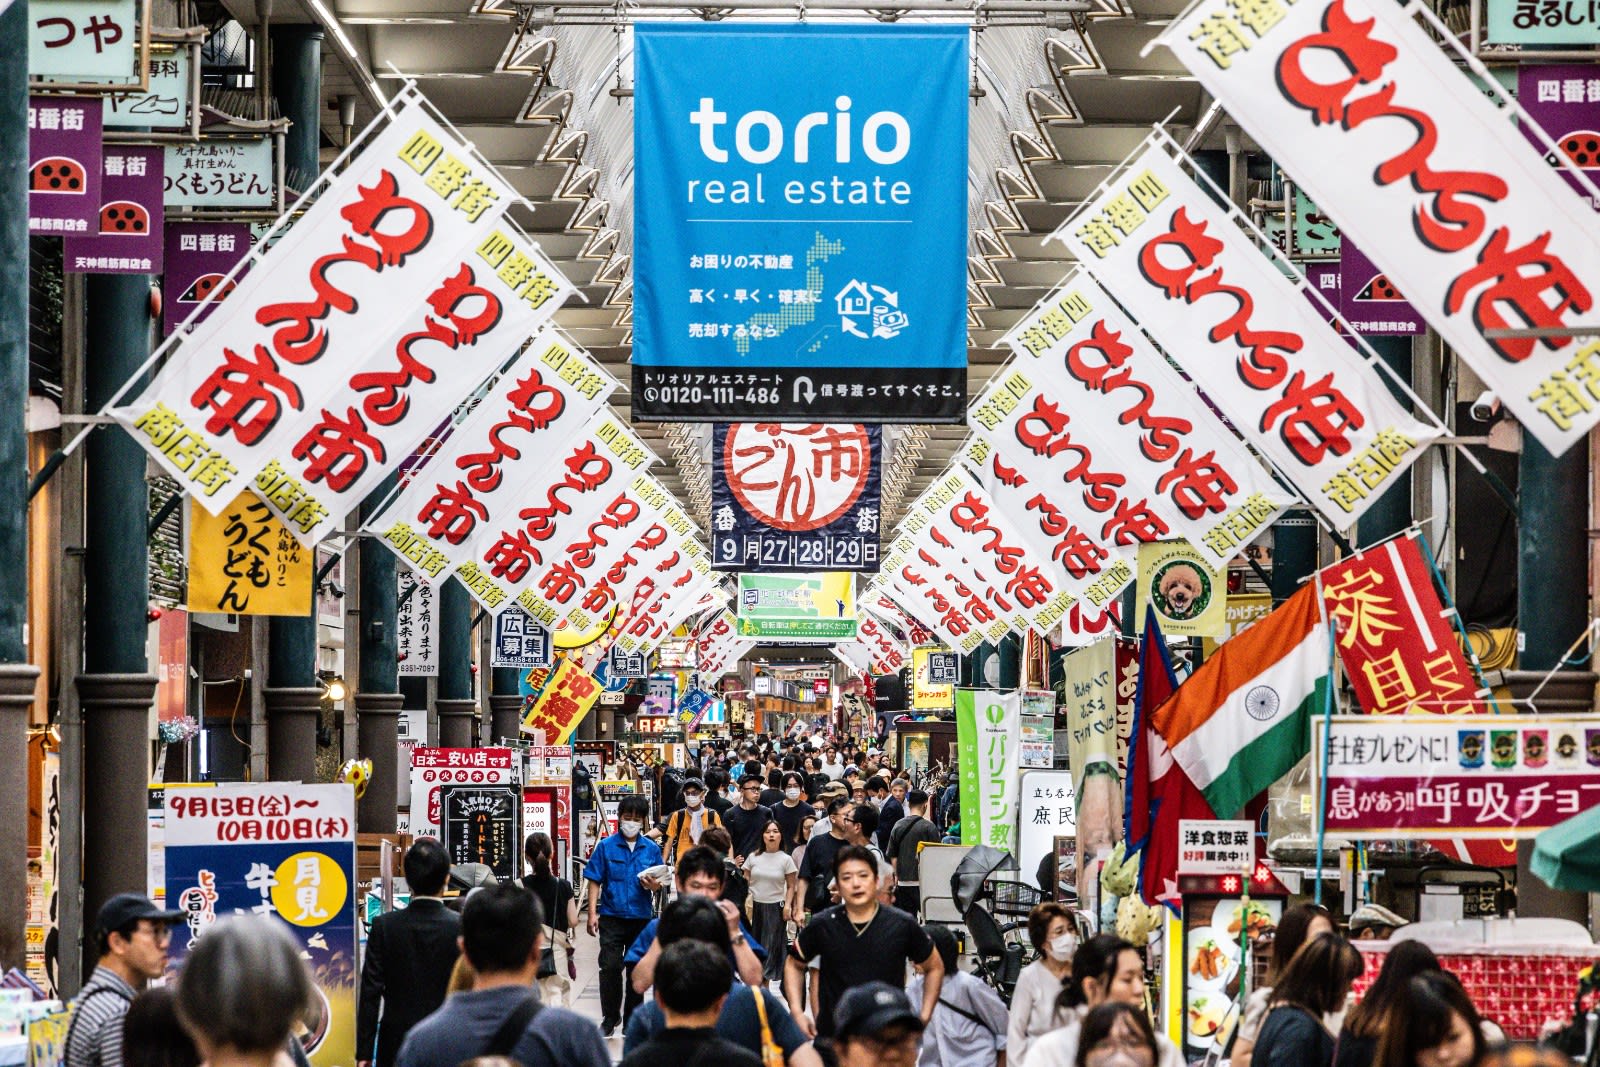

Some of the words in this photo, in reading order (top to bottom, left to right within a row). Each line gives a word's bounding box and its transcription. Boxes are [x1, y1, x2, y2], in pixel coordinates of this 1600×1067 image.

[37, 15, 123, 53] つや
[689, 95, 911, 165] torio
[184, 159, 237, 169] 真打生めん
[398, 129, 502, 224] 四番街
[688, 173, 765, 204] real
[784, 176, 911, 204] estate
[180, 234, 236, 252] 四番街
[475, 230, 560, 311] 四番街
[689, 254, 794, 270] お困りの不動産
[689, 289, 823, 304] 高く・早く・確実に
[688, 323, 777, 337] 売却するなら
[540, 342, 607, 401] 四番街
[644, 373, 784, 384] トリオリアルエステート
[660, 386, 780, 404] 0120-111-486
[821, 384, 961, 397] 信号渡ってすぐそこ。
[133, 401, 240, 498] 商店街
[716, 505, 737, 531] 番
[856, 507, 878, 533] 街
[217, 514, 249, 612] うどん
[383, 521, 453, 580] 商店街
[455, 559, 509, 611] 商店街
[504, 616, 546, 634] 広告
[503, 638, 541, 655] 募集
[417, 751, 508, 766] 日本一安い店です
[988, 734, 1011, 853] パソコン教
[217, 817, 348, 841] 10月10日(木)
[1185, 830, 1249, 846] 洋食惣菜
[294, 857, 329, 921] 月見
